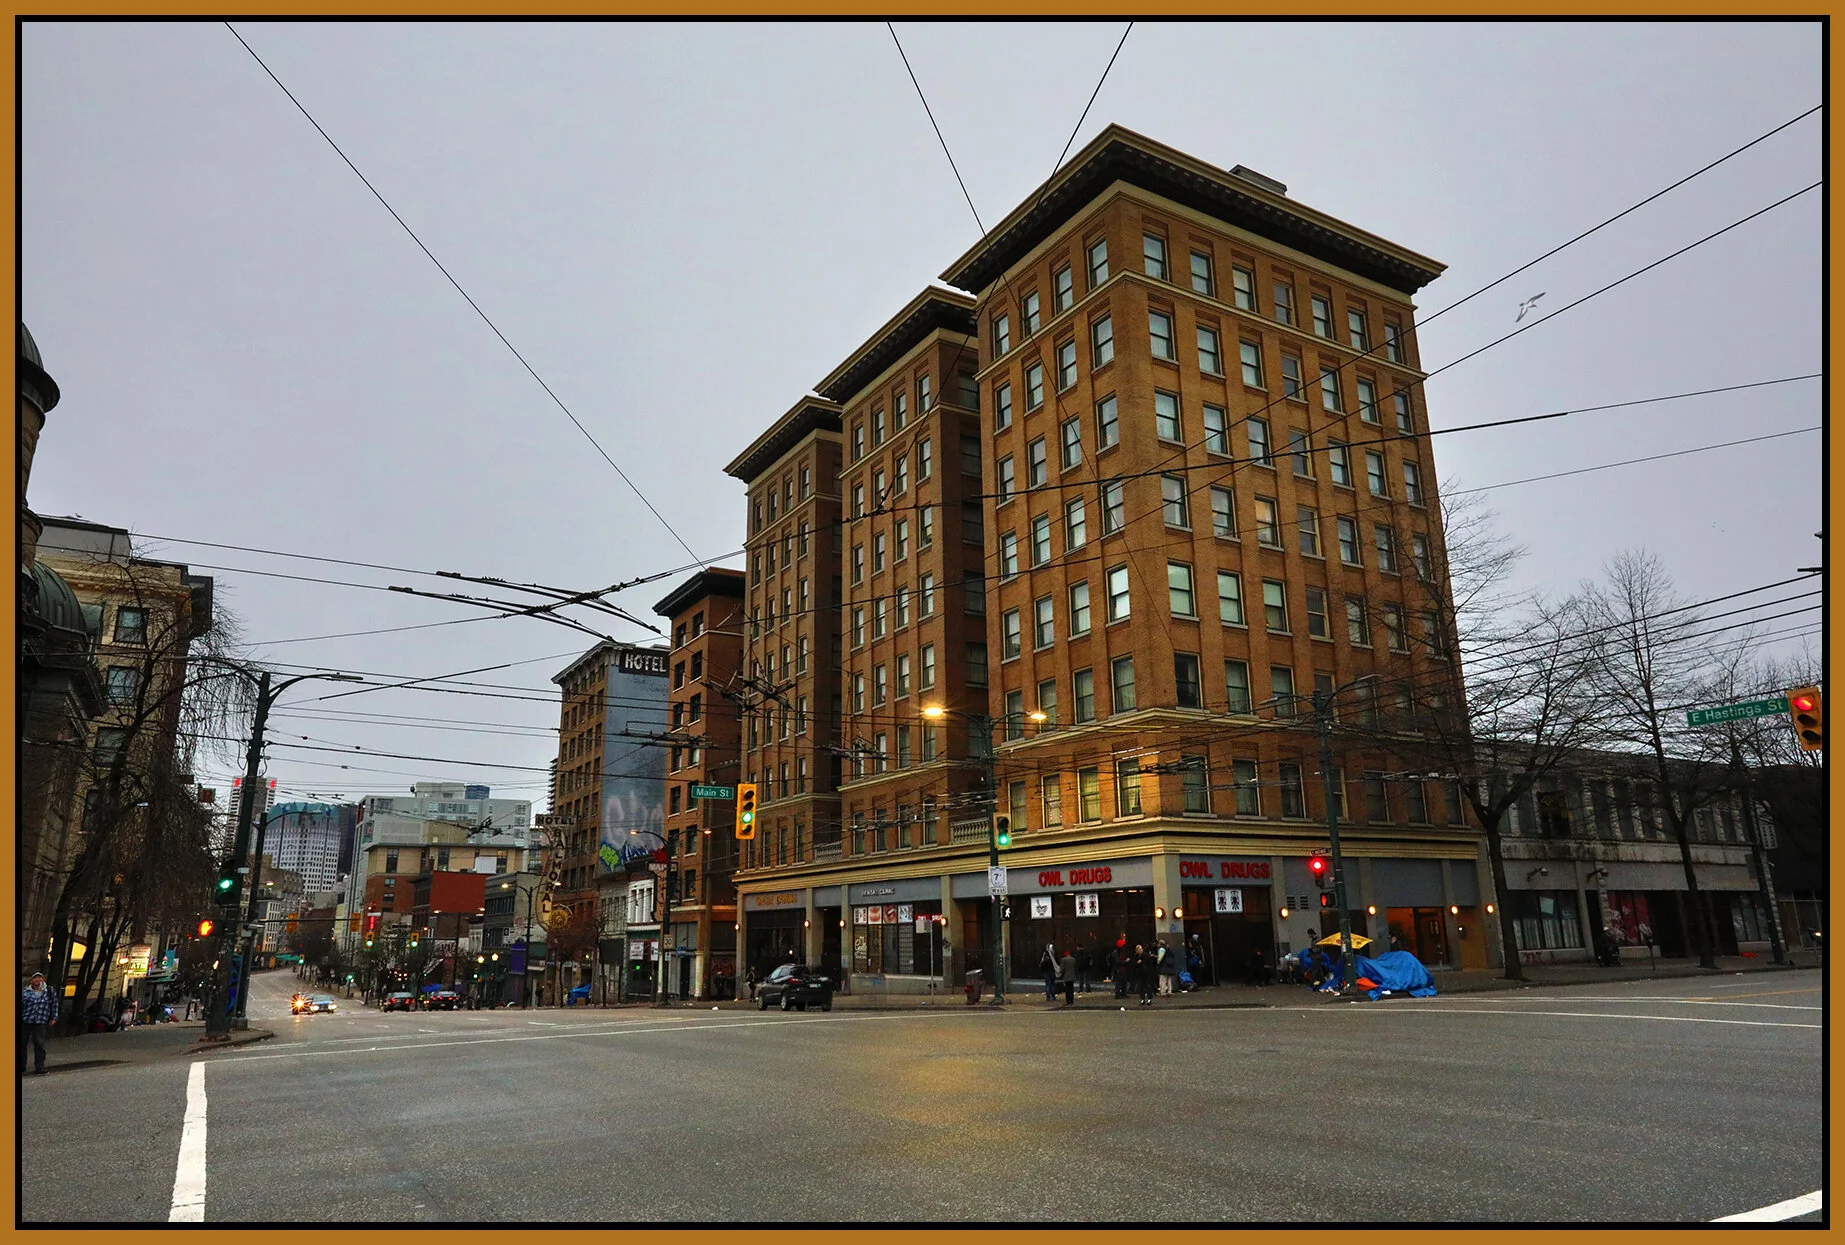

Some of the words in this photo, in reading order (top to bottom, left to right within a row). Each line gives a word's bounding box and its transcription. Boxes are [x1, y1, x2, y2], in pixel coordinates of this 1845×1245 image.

[625, 653, 666, 672] HOTEL
[1692, 712, 1701, 723] E
[1705, 704, 1762, 721] Hastings
[1767, 700, 1784, 711] St
[696, 788, 717, 797] Main
[719, 789, 729, 797] St
[537, 815, 575, 825] HOTEL
[542, 828, 565, 913] BALMORAL
[1038, 871, 1064, 887] OWL
[1069, 866, 1112, 885] DRUGS
[1180, 861, 1213, 878] OWL
[1221, 861, 1271, 879] DRUGS
